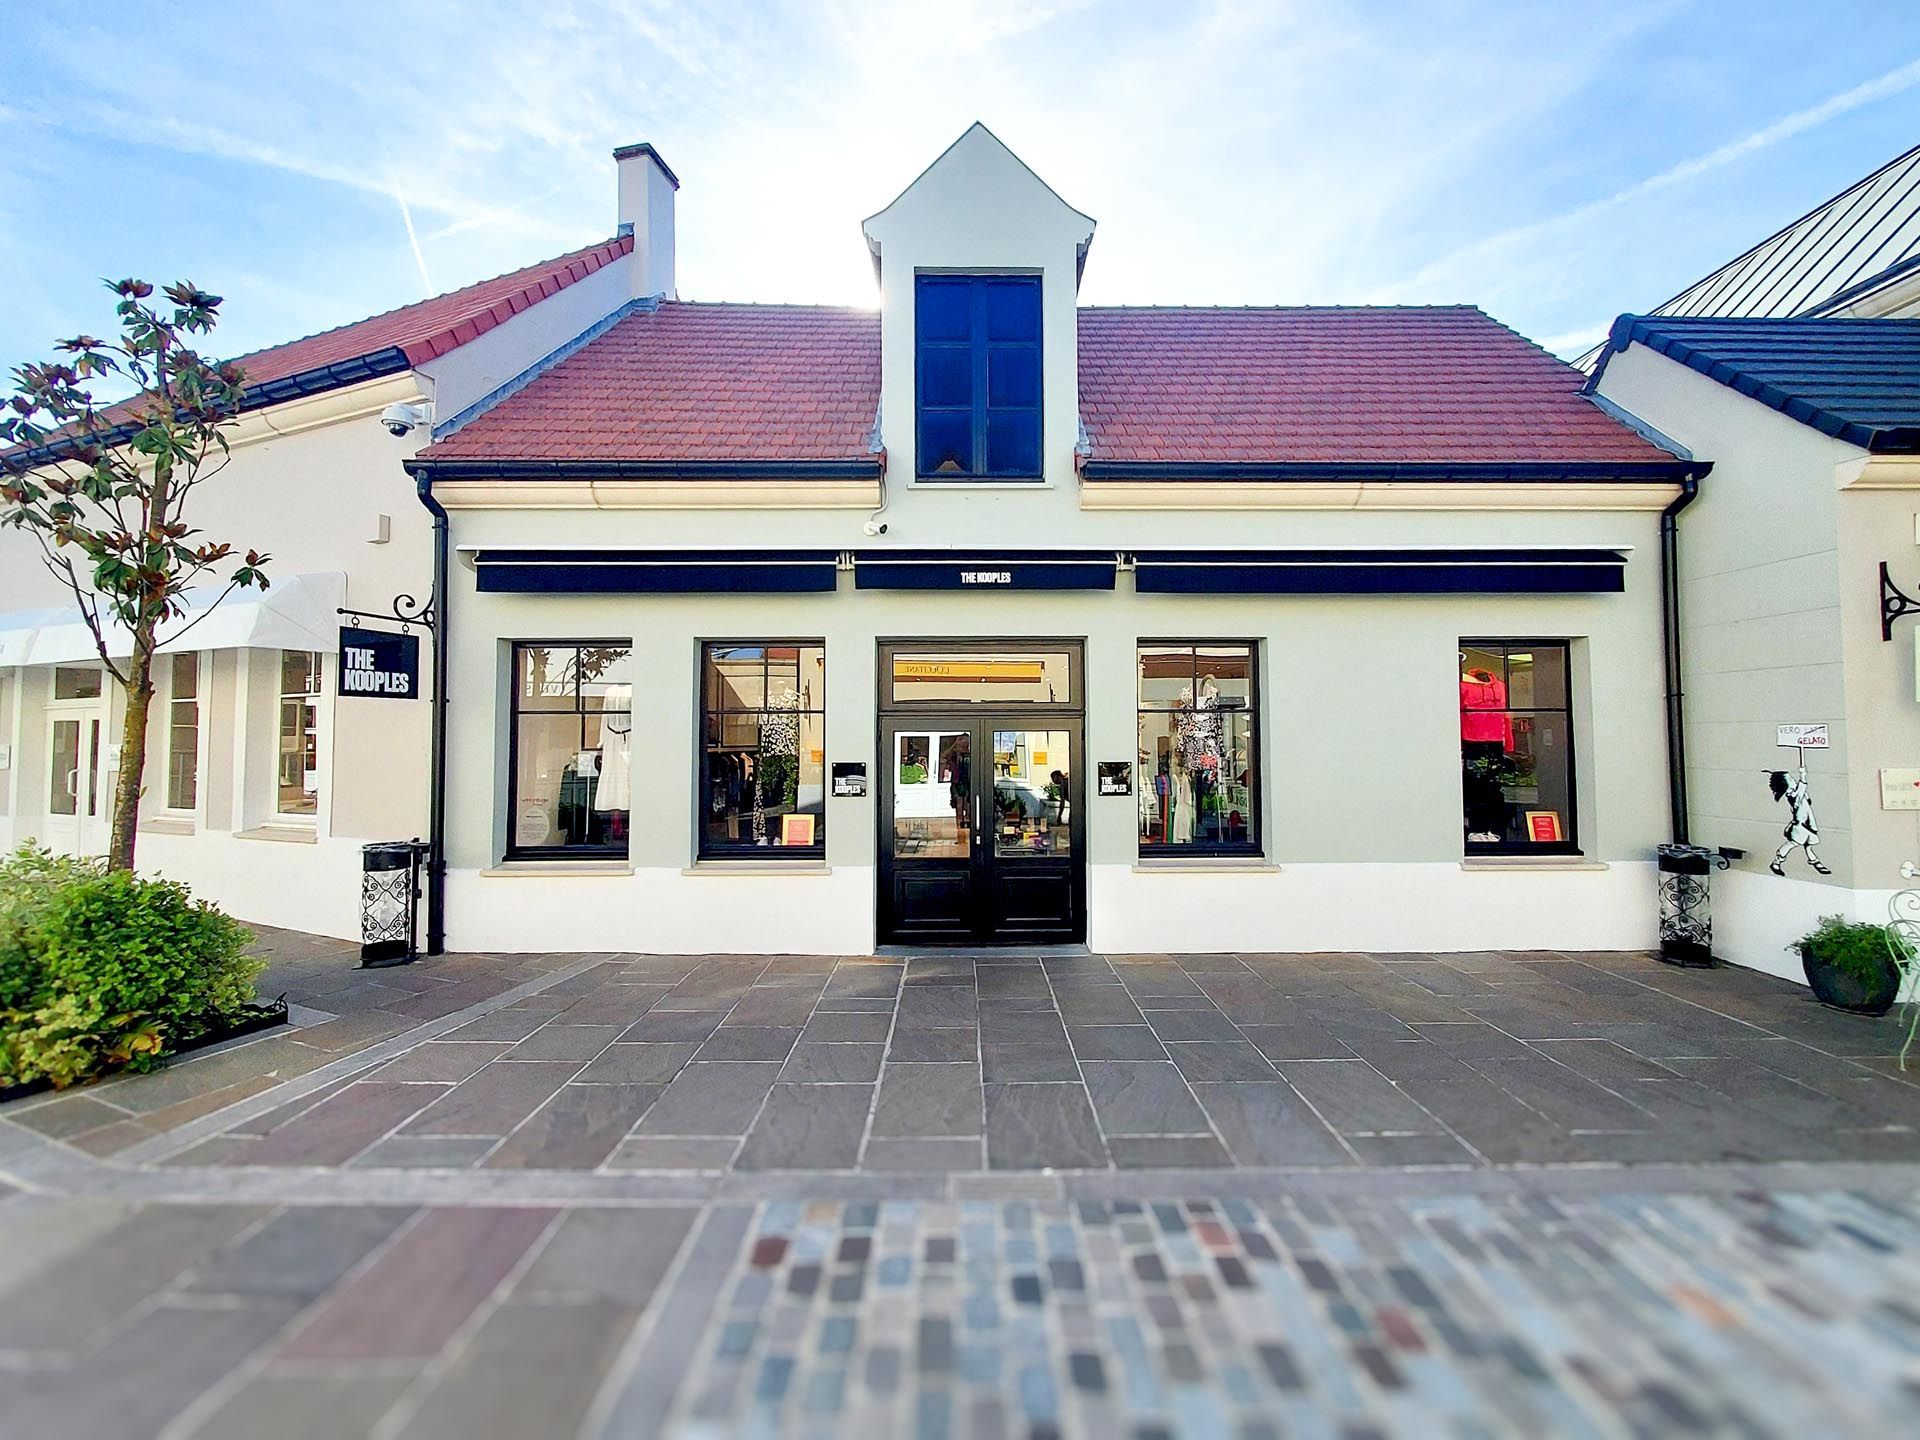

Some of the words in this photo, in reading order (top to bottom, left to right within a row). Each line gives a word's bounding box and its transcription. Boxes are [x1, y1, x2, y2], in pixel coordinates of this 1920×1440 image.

[960, 572, 977, 584] THE
[977, 572, 1012, 584] KOOPLES
[344, 647, 375, 670] THE
[344, 669, 409, 693] KOOPLES
[1797, 736, 1826, 745] GELATO
[834, 777, 847, 786] THE
[1100, 776, 1113, 785] THE
